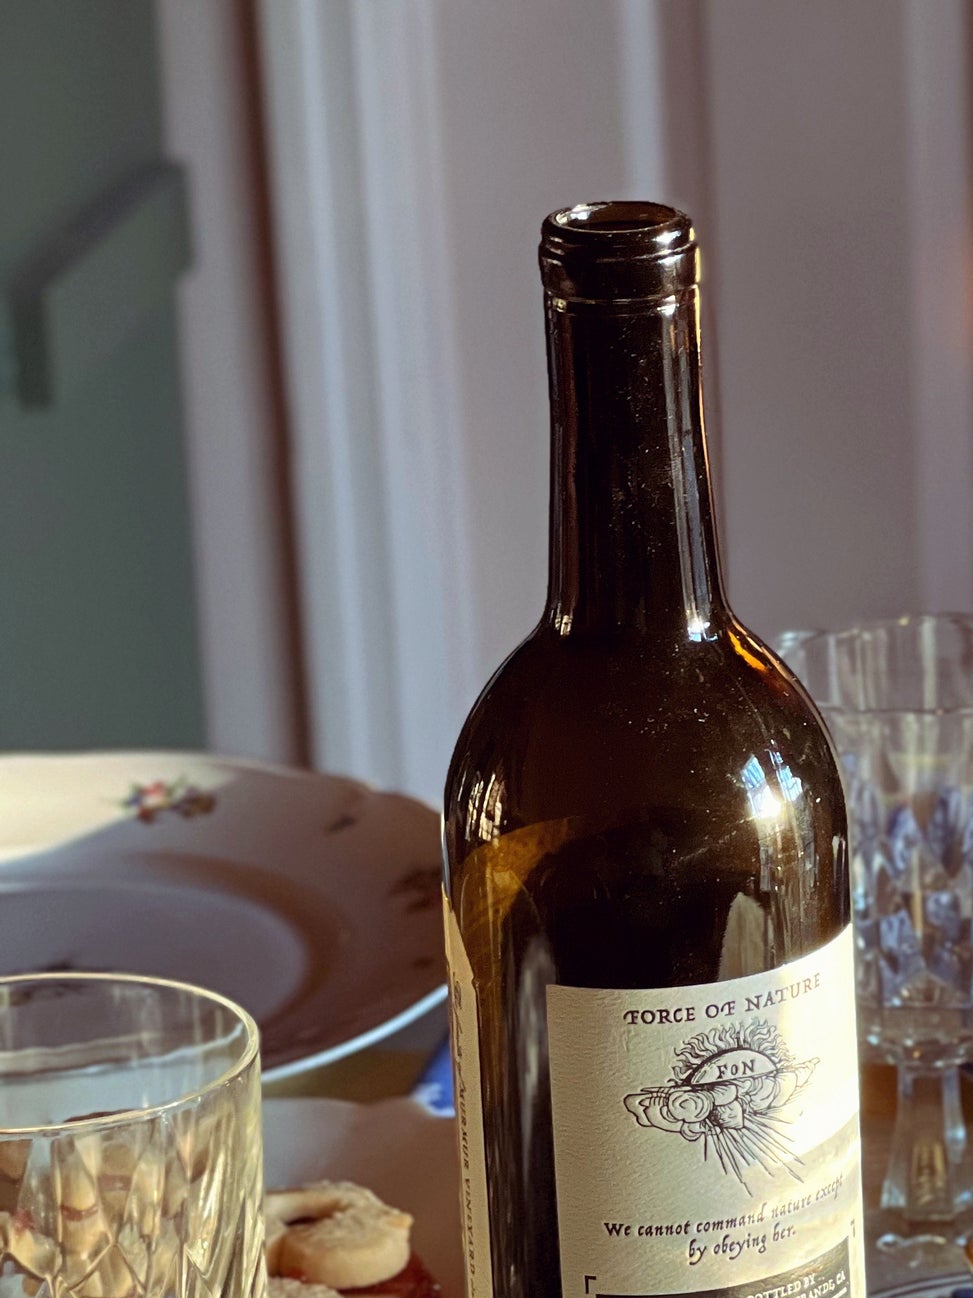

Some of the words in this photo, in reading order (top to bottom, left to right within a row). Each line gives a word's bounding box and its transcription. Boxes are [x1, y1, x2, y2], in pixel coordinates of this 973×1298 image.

[622, 1006, 696, 1025] FORCE
[705, 1001, 736, 1018] OF
[745, 973, 821, 1012] NATURE
[464, 1178, 476, 1275] VINEYARD
[603, 1222, 632, 1237] We
[637, 1220, 692, 1237] cannot
[696, 1202, 768, 1234] command
[771, 1195, 813, 1219] nature
[815, 1173, 844, 1202] except
[688, 1239, 707, 1266] by
[713, 1233, 767, 1260] obeying
[803, 1273, 816, 1288] BY
